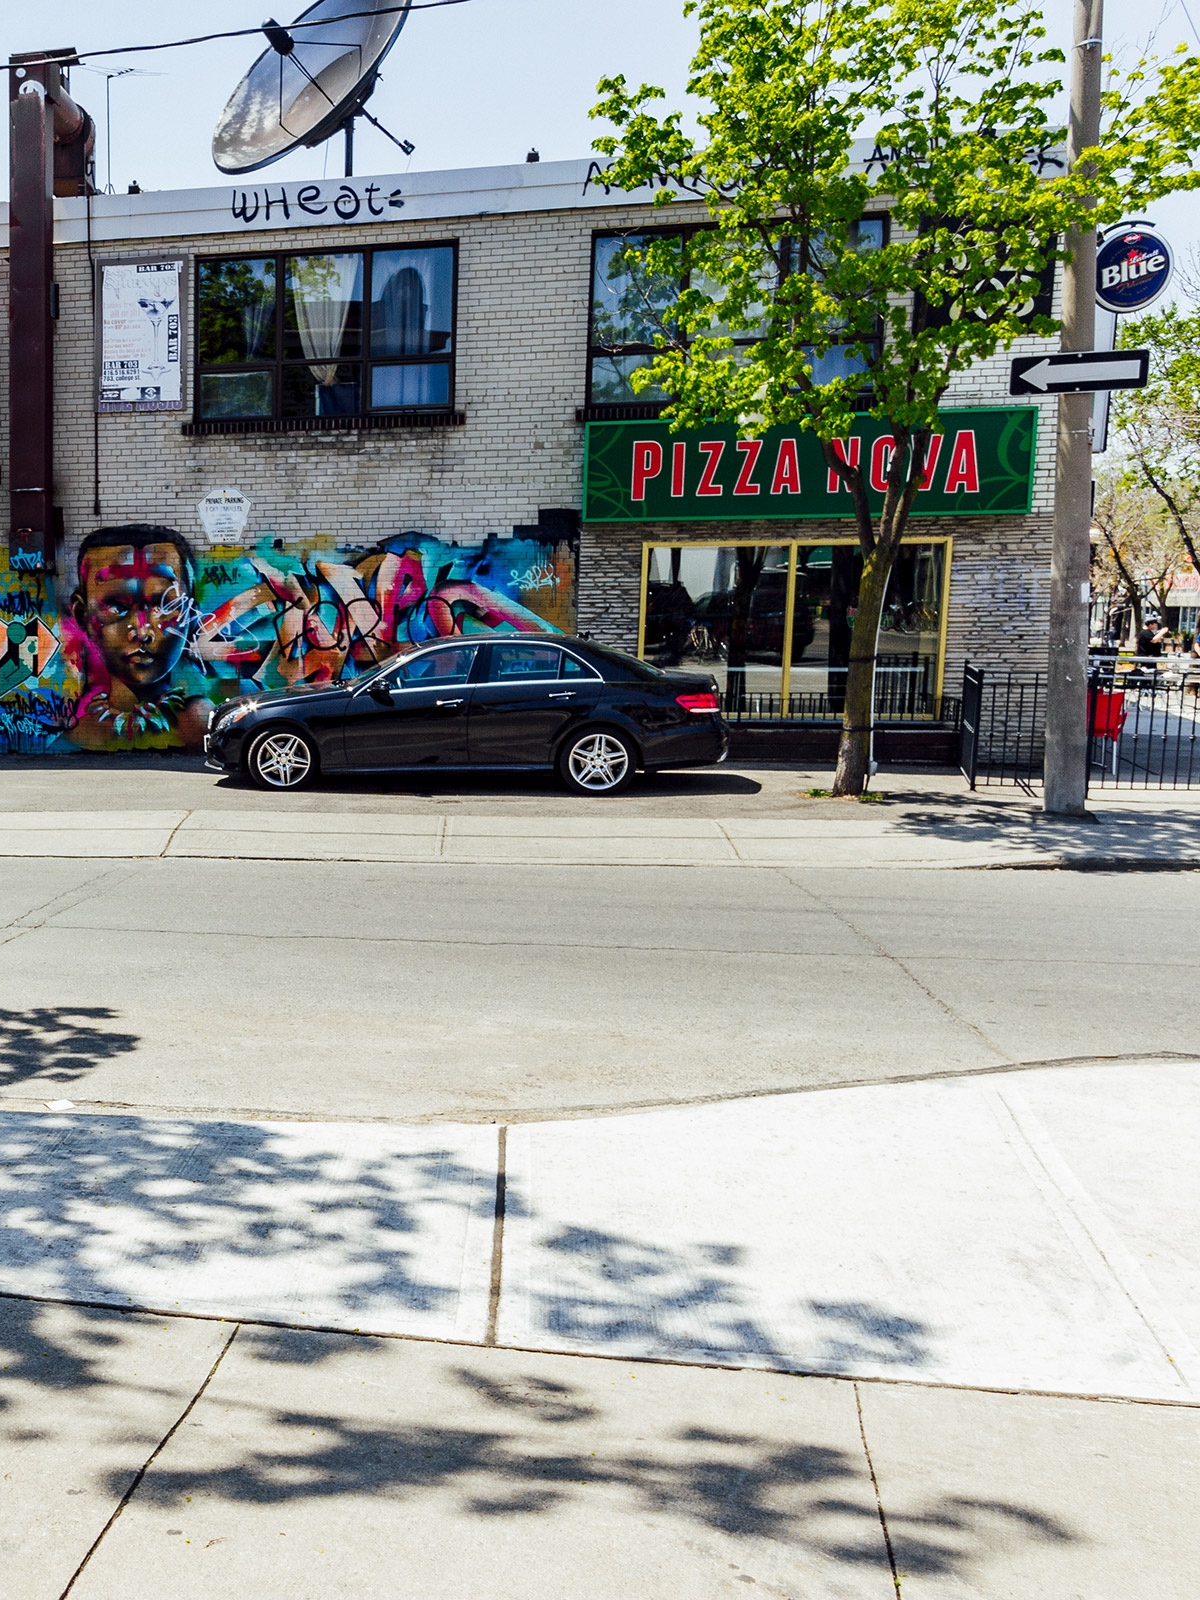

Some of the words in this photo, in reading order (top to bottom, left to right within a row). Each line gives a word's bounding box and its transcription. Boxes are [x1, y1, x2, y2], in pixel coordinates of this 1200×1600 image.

[138, 264, 157, 272] BAR
[160, 263, 177, 271] 703
[1102, 255, 1166, 289] Blue
[168, 315, 178, 335] 703
[168, 338, 178, 361] BAR
[105, 361, 122, 369] BAR
[631, 438, 802, 501] PIZZA
